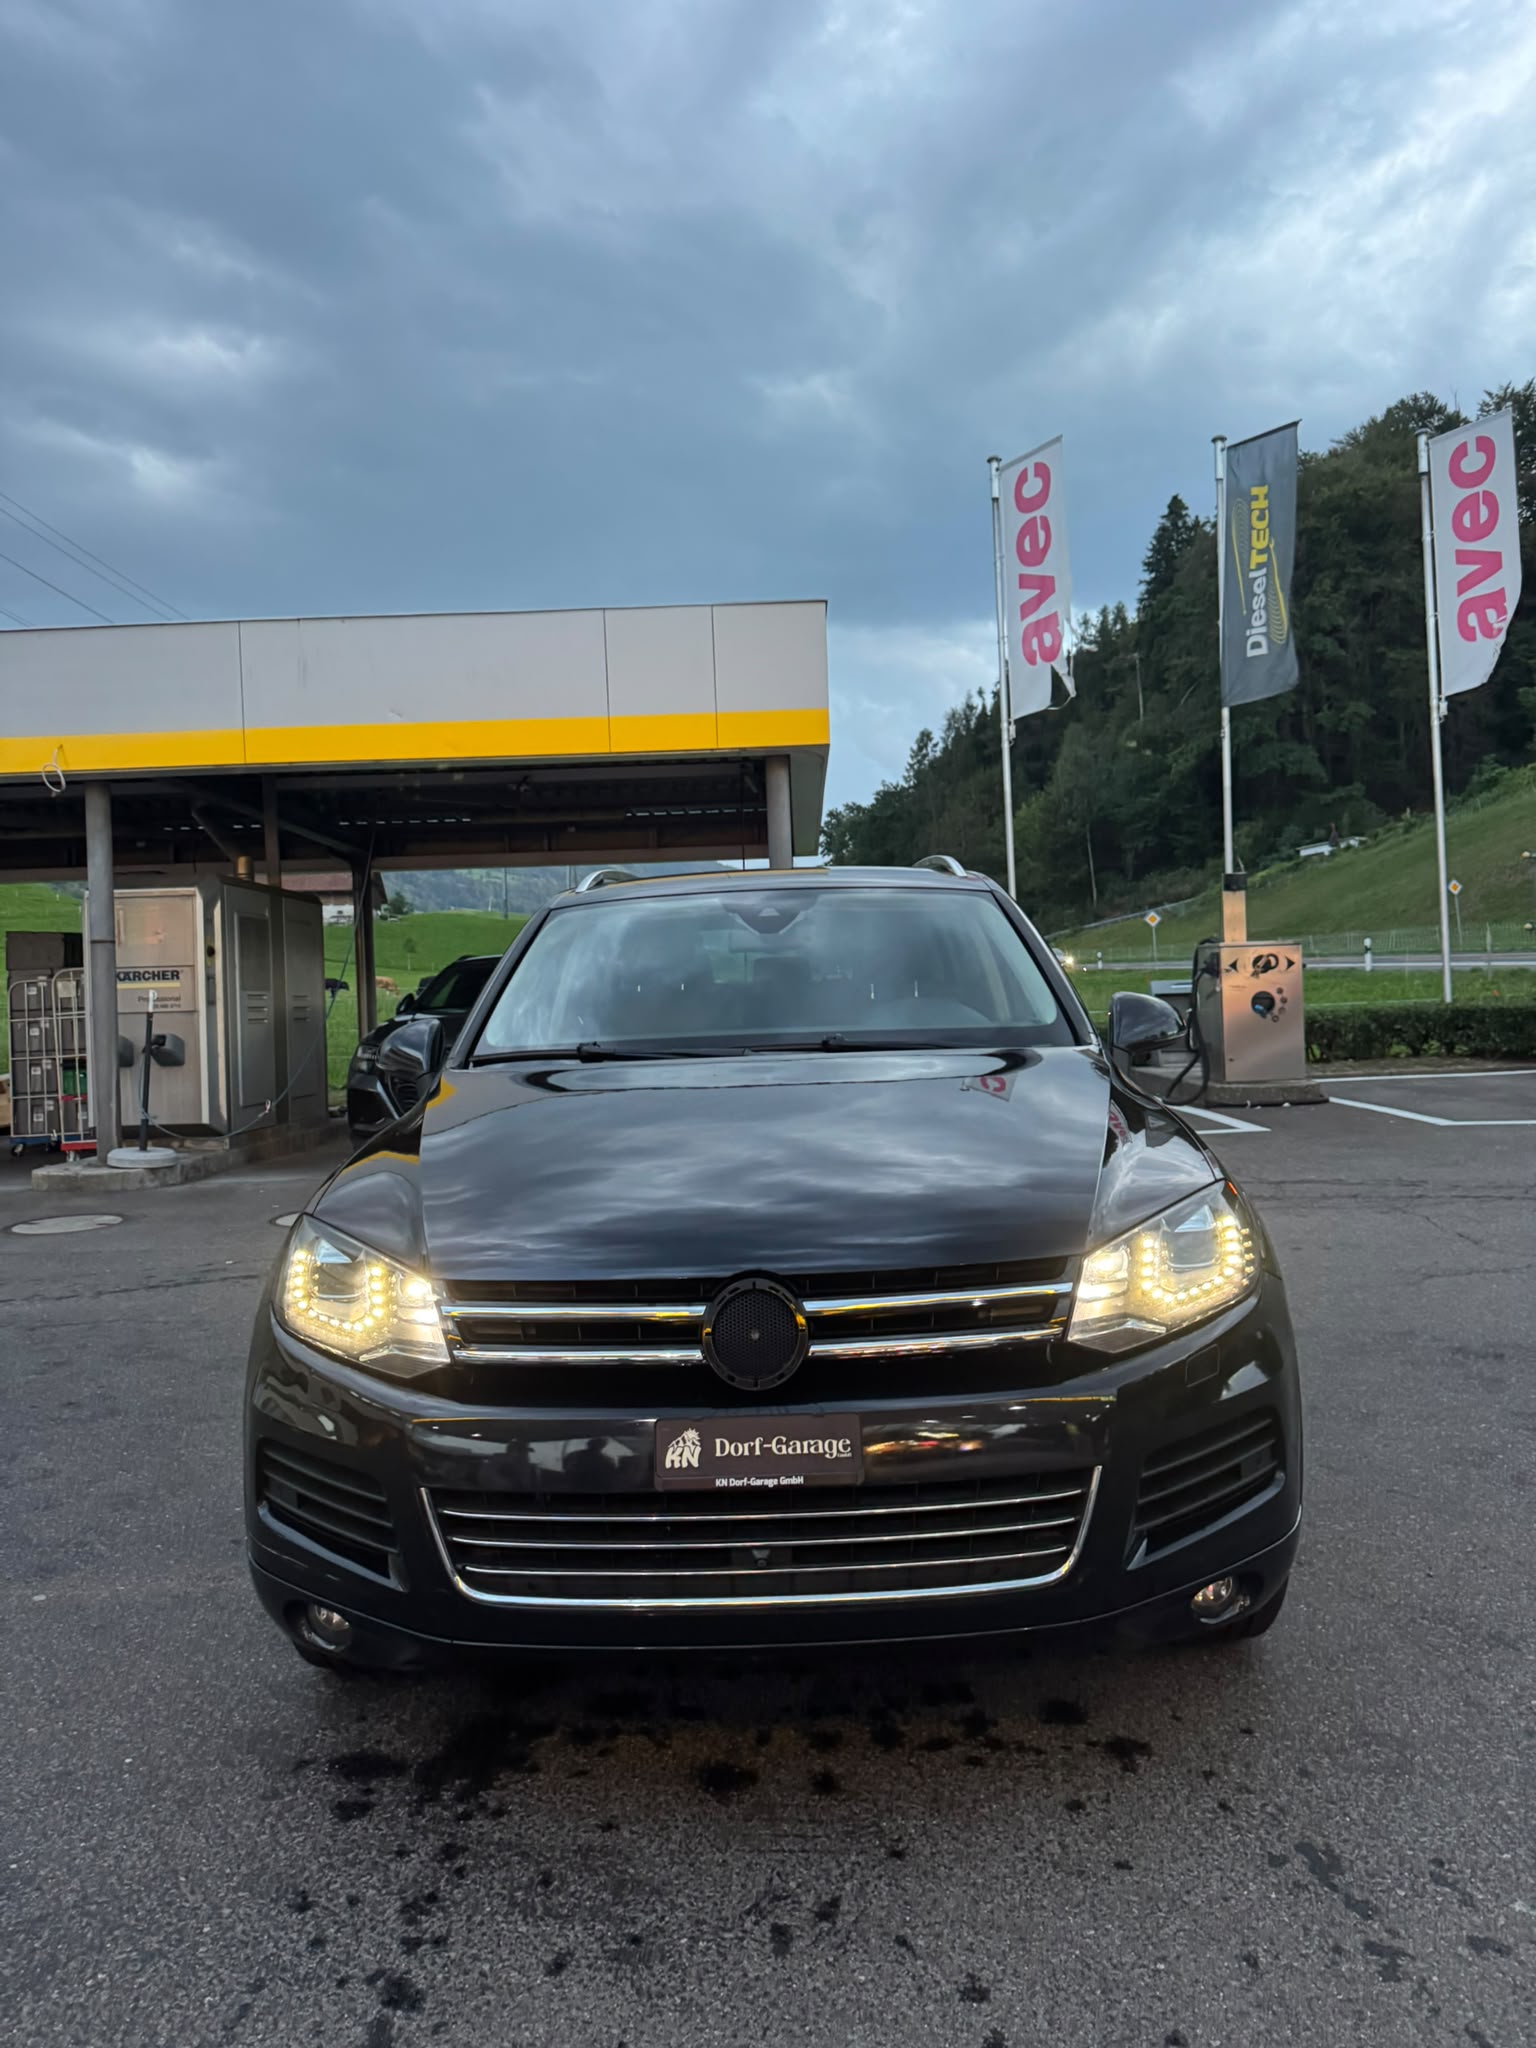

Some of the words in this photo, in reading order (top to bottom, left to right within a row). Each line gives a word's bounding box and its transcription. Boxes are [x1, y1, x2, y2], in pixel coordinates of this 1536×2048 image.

[1014, 461, 1064, 666] avec
[1246, 484, 1270, 658] DieselTECH
[1448, 435, 1508, 643] avec
[665, 1445, 702, 1469] KN
[715, 1435, 851, 1460] Dorf-Garage
[715, 1479, 728, 1487] KN
[729, 1477, 779, 1489] Dorf-Garage
[780, 1475, 804, 1485] GmbH
